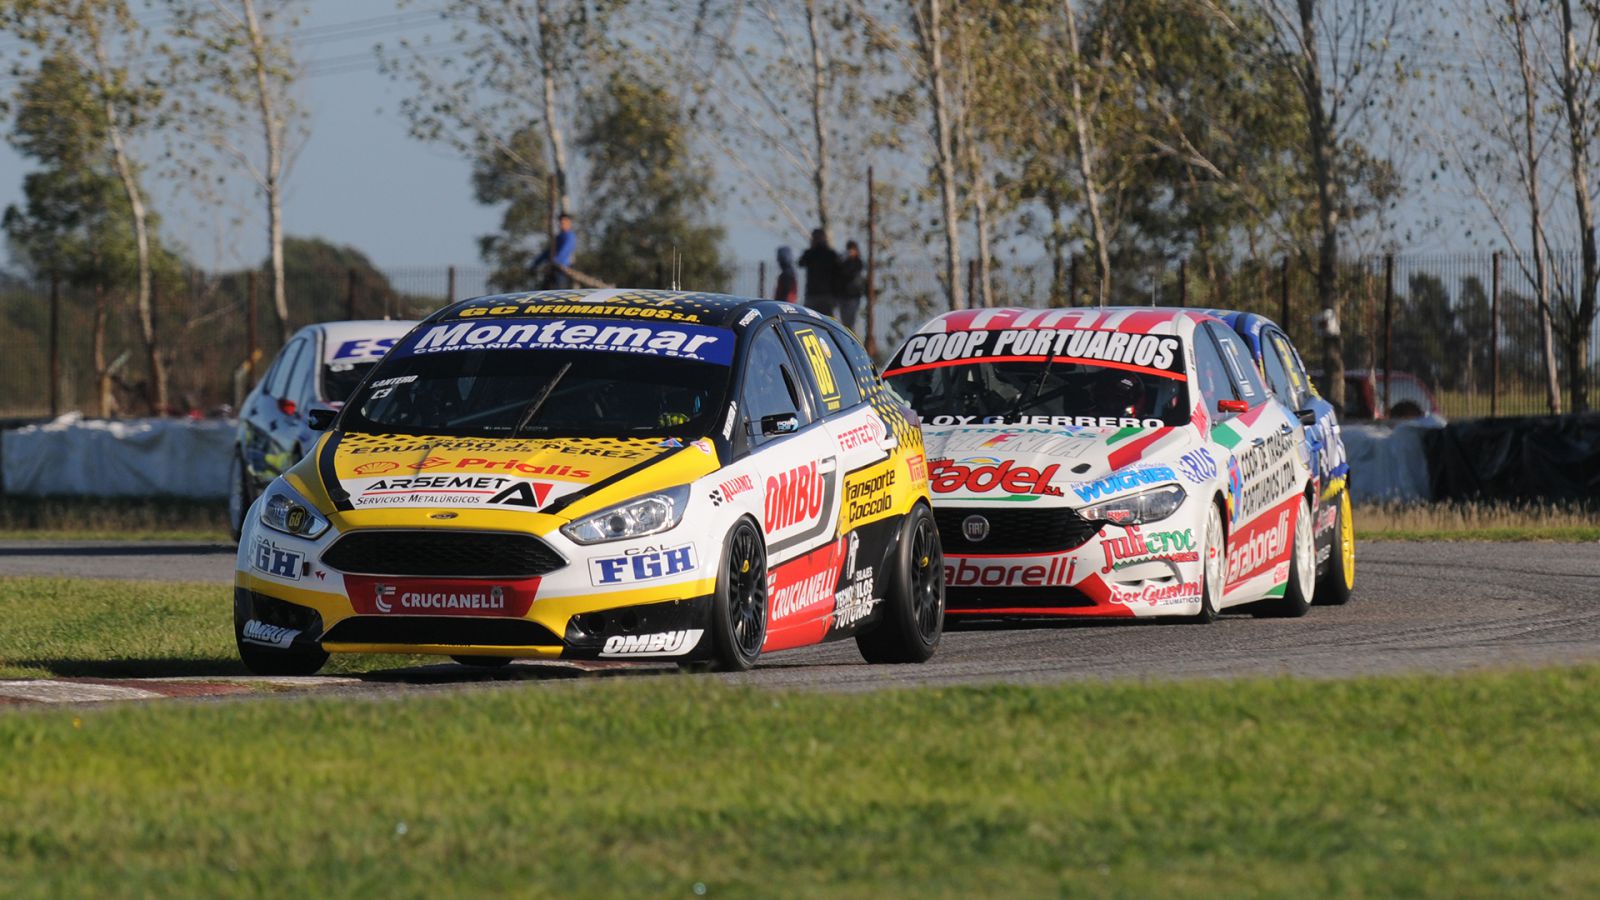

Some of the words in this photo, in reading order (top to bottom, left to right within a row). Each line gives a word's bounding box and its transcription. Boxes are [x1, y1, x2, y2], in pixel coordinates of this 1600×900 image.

[458, 305, 519, 317] GC
[524, 304, 673, 319] NEUMATICOS
[671, 312, 701, 323] S.A.
[968, 309, 1140, 330] FIAT
[414, 320, 718, 353] Montemar
[529, 342, 660, 354] FINANCIERA
[901, 331, 988, 367] COOP.
[992, 329, 1178, 370] PORTUARIOS
[370, 375, 419, 389] SANTERO
[351, 441, 496, 455] EDUARDO
[837, 424, 874, 452] FERTEC
[455, 457, 593, 479] Prialis
[1180, 447, 1217, 484] RUS
[365, 476, 511, 490] ARSEMET
[845, 469, 895, 503] Transporte
[355, 494, 406, 506] SERVICIOS
[764, 460, 824, 535] OMBU
[848, 491, 892, 523] Coccolo
[289, 512, 302, 527] 68
[967, 522, 984, 535] FIAT
[252, 543, 300, 578] GH
[624, 544, 670, 556] CAL
[595, 546, 695, 584] FGH
[401, 592, 504, 608] CRUCIANELLI
[772, 566, 837, 621] CRUCIANELLI
[242, 619, 296, 646] OMBU
[600, 630, 694, 655] OMBU
